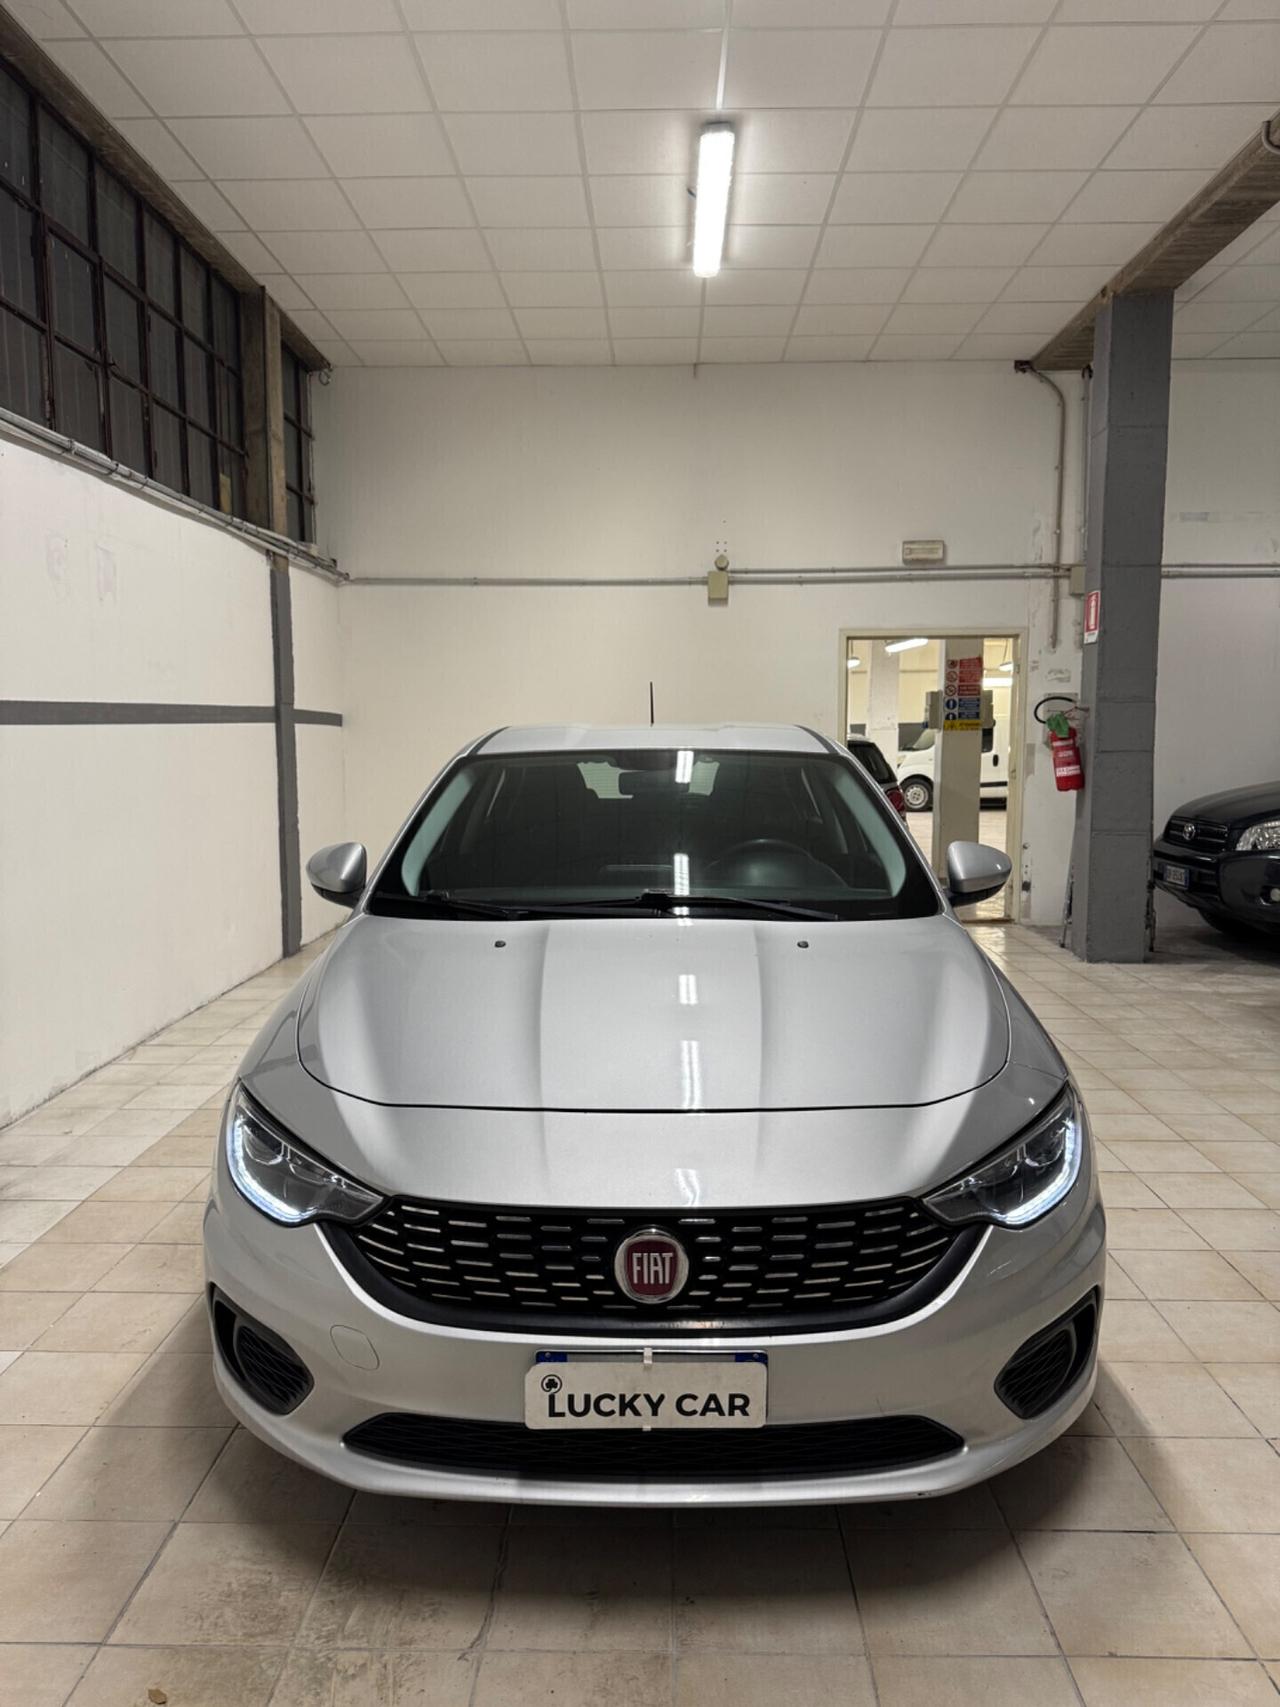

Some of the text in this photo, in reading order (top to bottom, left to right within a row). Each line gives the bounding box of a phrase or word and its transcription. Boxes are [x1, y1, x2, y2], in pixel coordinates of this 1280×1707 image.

[632, 1252, 674, 1285] FIAT
[547, 1392, 750, 1418] LUCKY CAR
